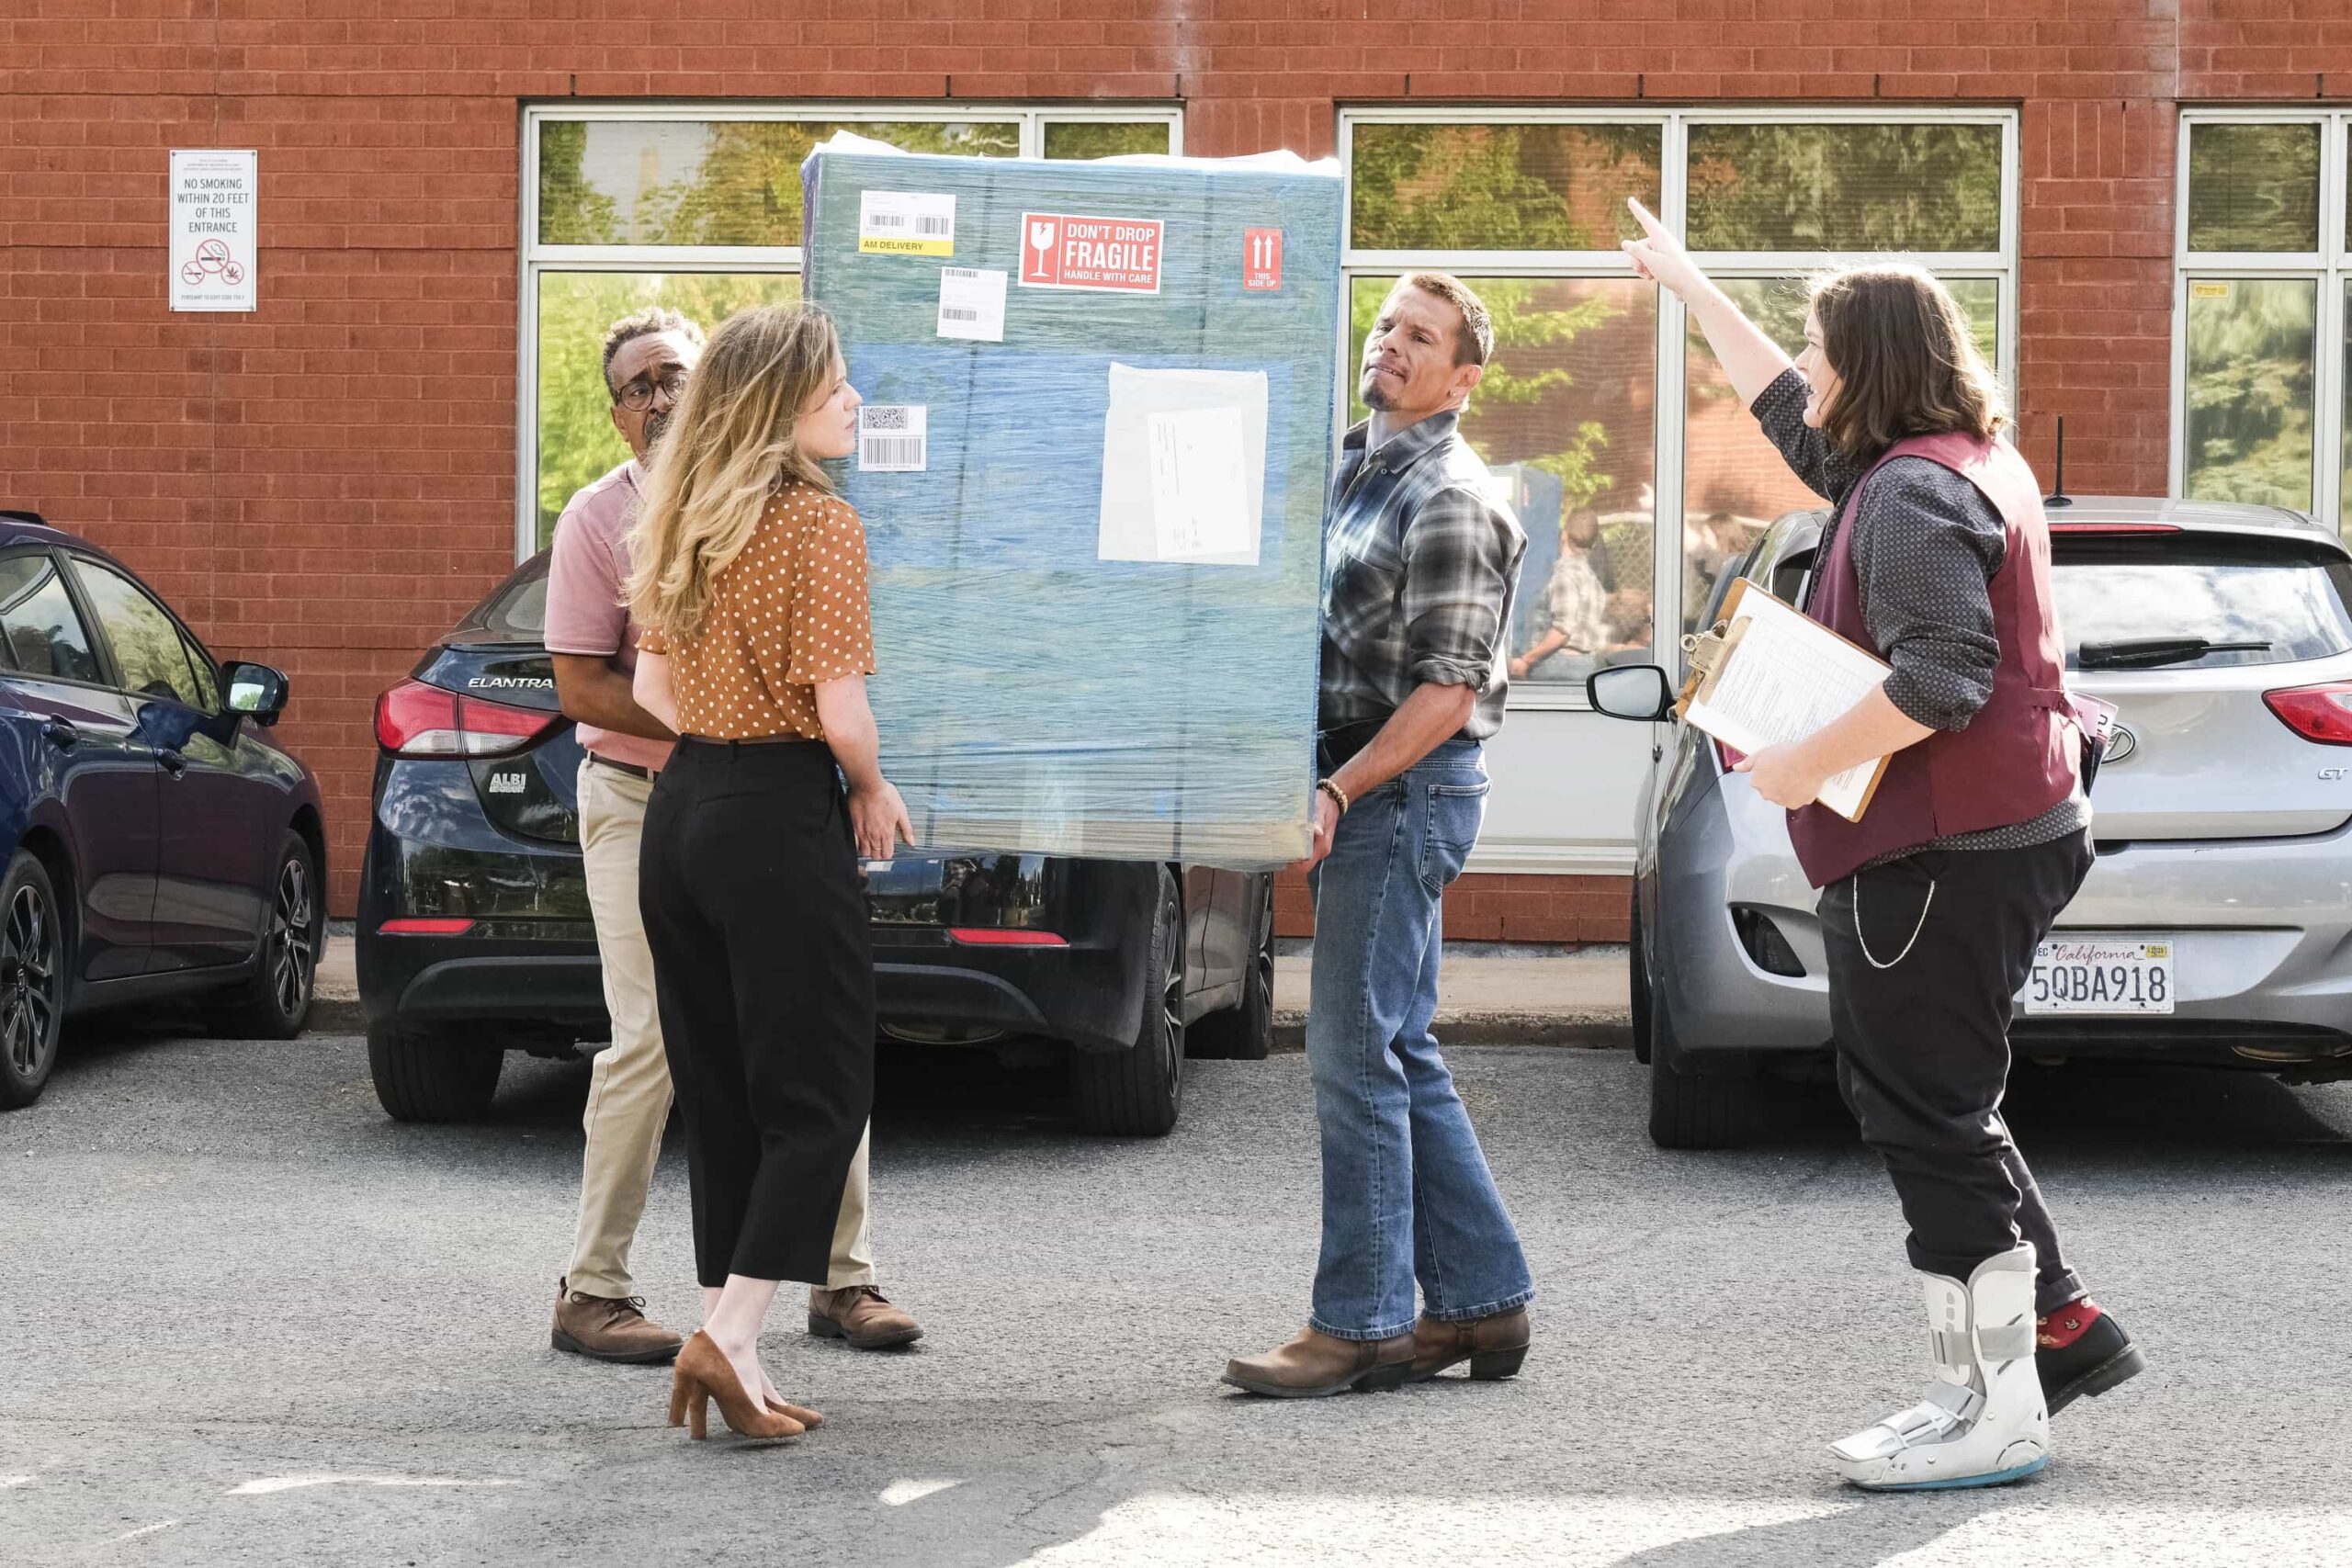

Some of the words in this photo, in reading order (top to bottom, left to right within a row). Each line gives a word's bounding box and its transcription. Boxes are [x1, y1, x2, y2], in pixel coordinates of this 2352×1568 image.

[184, 178, 198, 189] NO
[199, 178, 243, 189] SMOKING
[177, 193, 209, 204] WITHIN
[212, 193, 225, 204] 20
[227, 193, 250, 204] FEET
[195, 208, 207, 219] OF
[210, 208, 231, 219] THIS
[188, 221, 238, 232] ENTRANCE
[1067, 223, 1111, 241] DON'T
[1114, 227, 1156, 242] DROP
[879, 241, 923, 251] DELIVERY
[1065, 241, 1155, 272] FRAGILE
[1064, 269, 1101, 281] HANDLE
[1102, 272, 1125, 282] WITH
[1128, 273, 1153, 284] CARE
[468, 677, 554, 689] ELANTRA
[490, 773, 526, 786] ALBI
[2317, 768, 2349, 781] GT
[2036, 947, 2049, 957] EC
[2055, 944, 2144, 965] California
[2031, 965, 2165, 1002] 5QBA918
